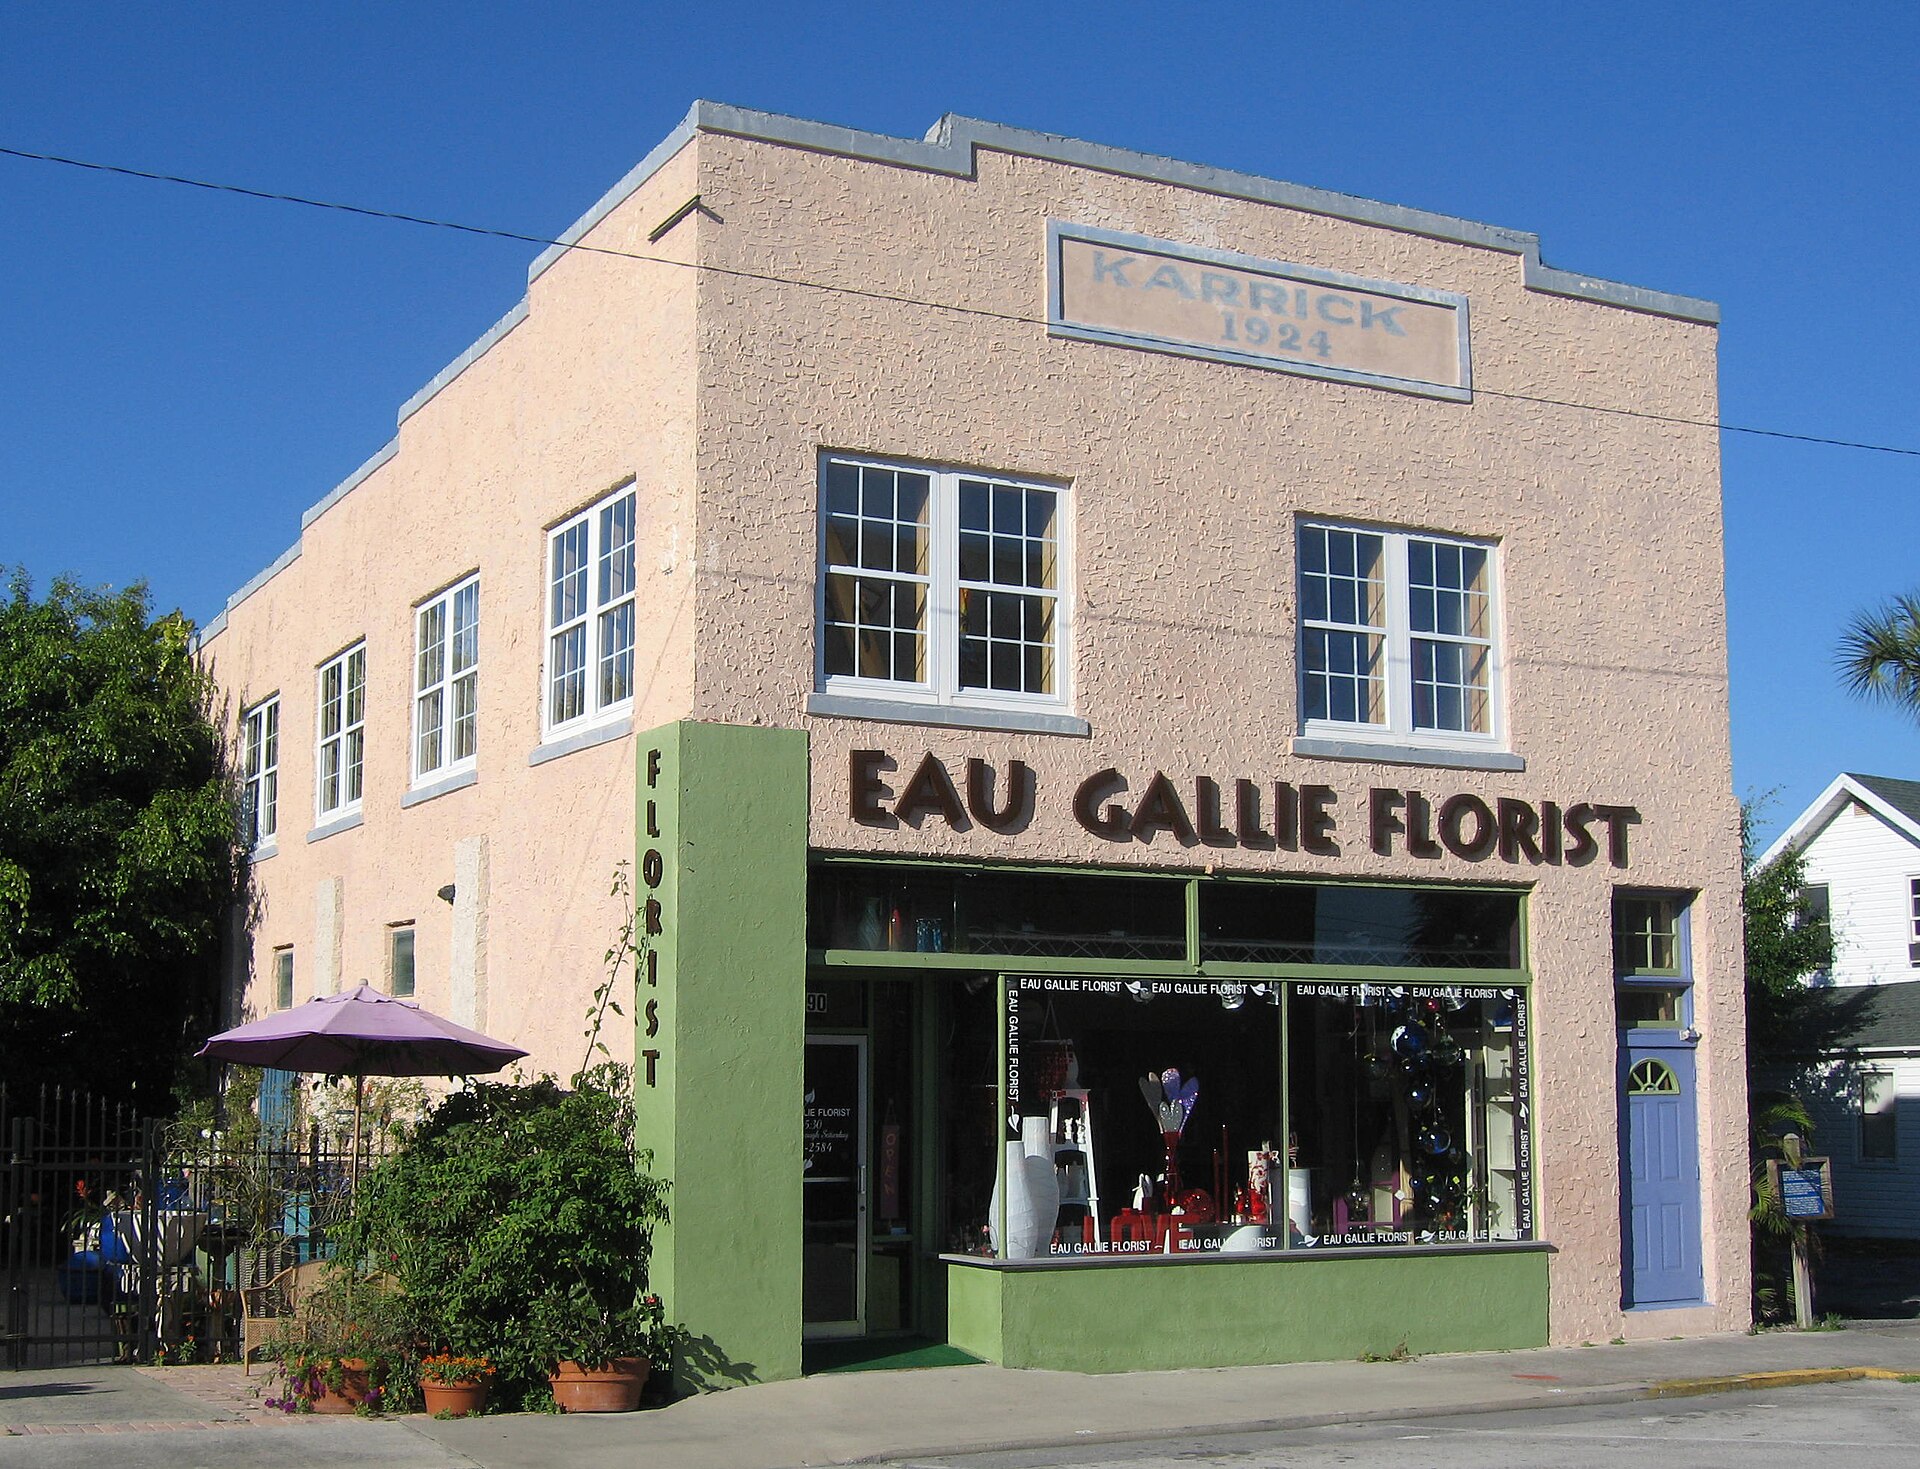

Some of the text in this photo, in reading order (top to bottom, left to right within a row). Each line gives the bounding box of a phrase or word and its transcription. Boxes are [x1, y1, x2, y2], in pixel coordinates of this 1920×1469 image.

[1093, 250, 1408, 337] KARRICK
[1221, 311, 1332, 358] 1924
[849, 749, 1641, 868] EAU GALLIE FLORIST
[642, 748, 663, 1089] FLORIST
[1020, 978, 1122, 992] EAU GALLIE FLORIST
[1151, 982, 1247, 995] EAU GALLIE FLORIST
[1297, 985, 1386, 997] EAU GALLIE FLORIST
[1412, 987, 1498, 999] EAU GALLIE FLORIST
[1008, 990, 1019, 1102] EAU GALLIE FLORIST
[1517, 998, 1528, 1098] EAU GALLIE FLORIST
[817, 1108, 850, 1117] FLORIST
[1520, 1128, 1531, 1230] EAU GALLIE FLORIST
[1323, 1231, 1412, 1245] EAU GALLIE FLORIST
[1438, 1230, 1456, 1241] EAU
[1050, 1240, 1151, 1254] EAU GALLIE FLORIST
[1181, 1239, 1201, 1250] EAU
